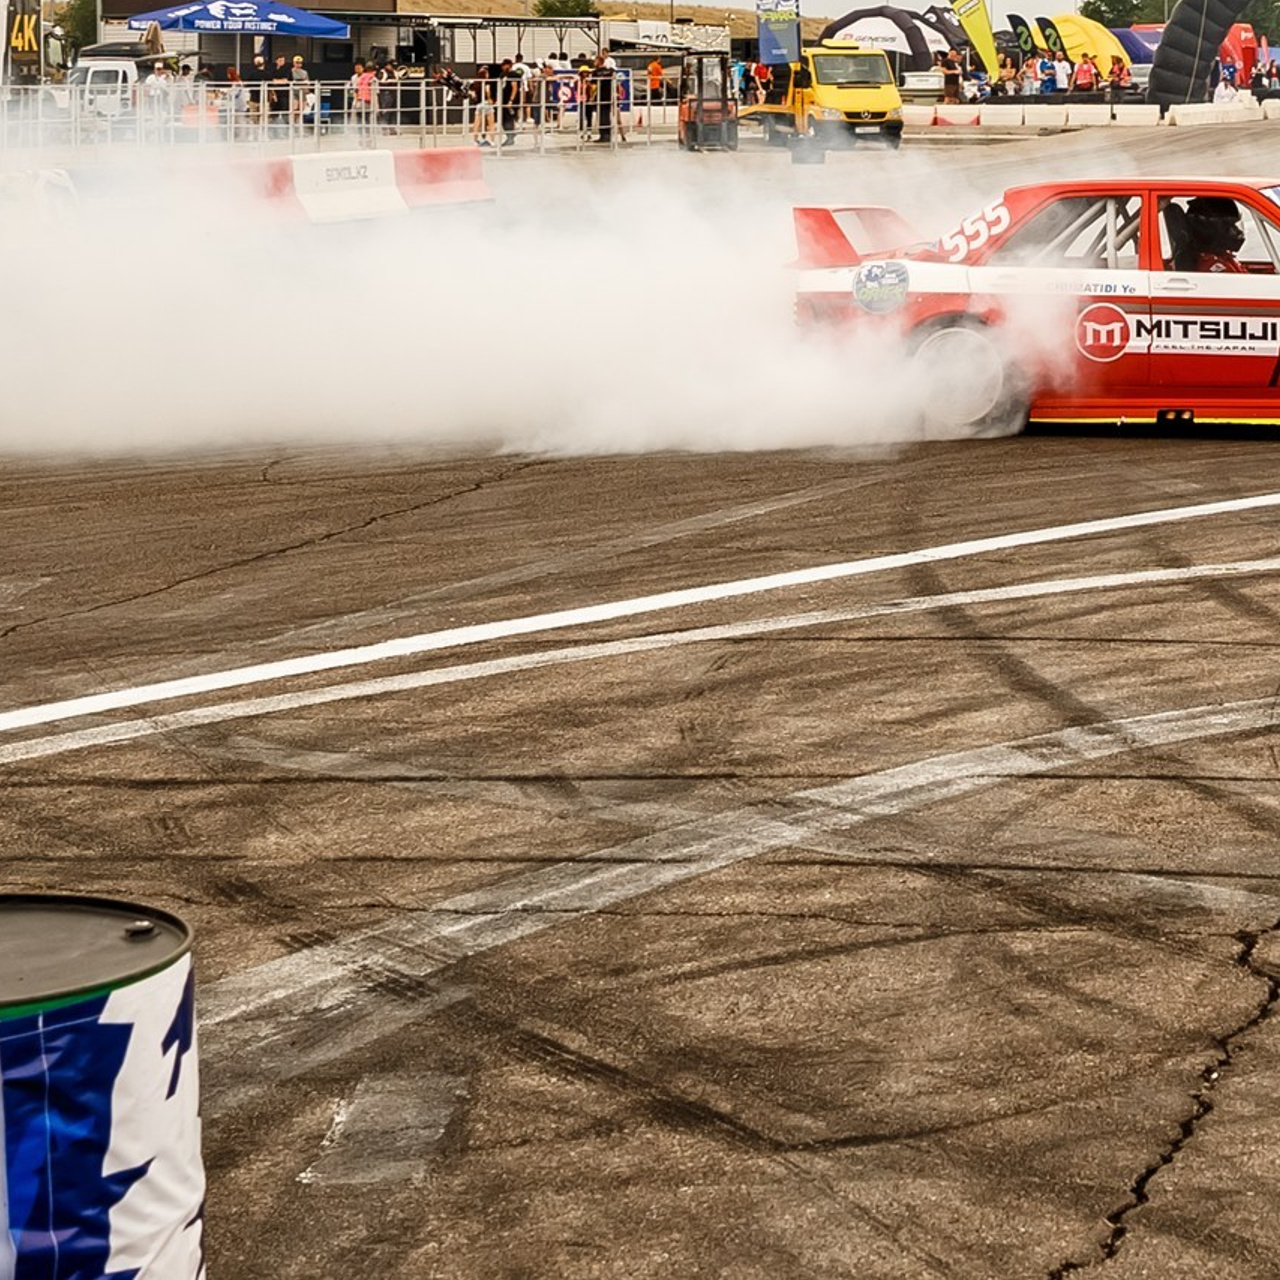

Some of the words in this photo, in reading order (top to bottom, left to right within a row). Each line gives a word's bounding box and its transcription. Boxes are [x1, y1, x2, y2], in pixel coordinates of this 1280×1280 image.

[11, 14, 38, 51] 4K
[194, 20, 221, 29] POWER
[223, 21, 243, 30] YOUR
[244, 21, 278, 31] INSTINCT
[940, 195, 1011, 263] 555
[1135, 319, 1278, 341] MITSUJI
